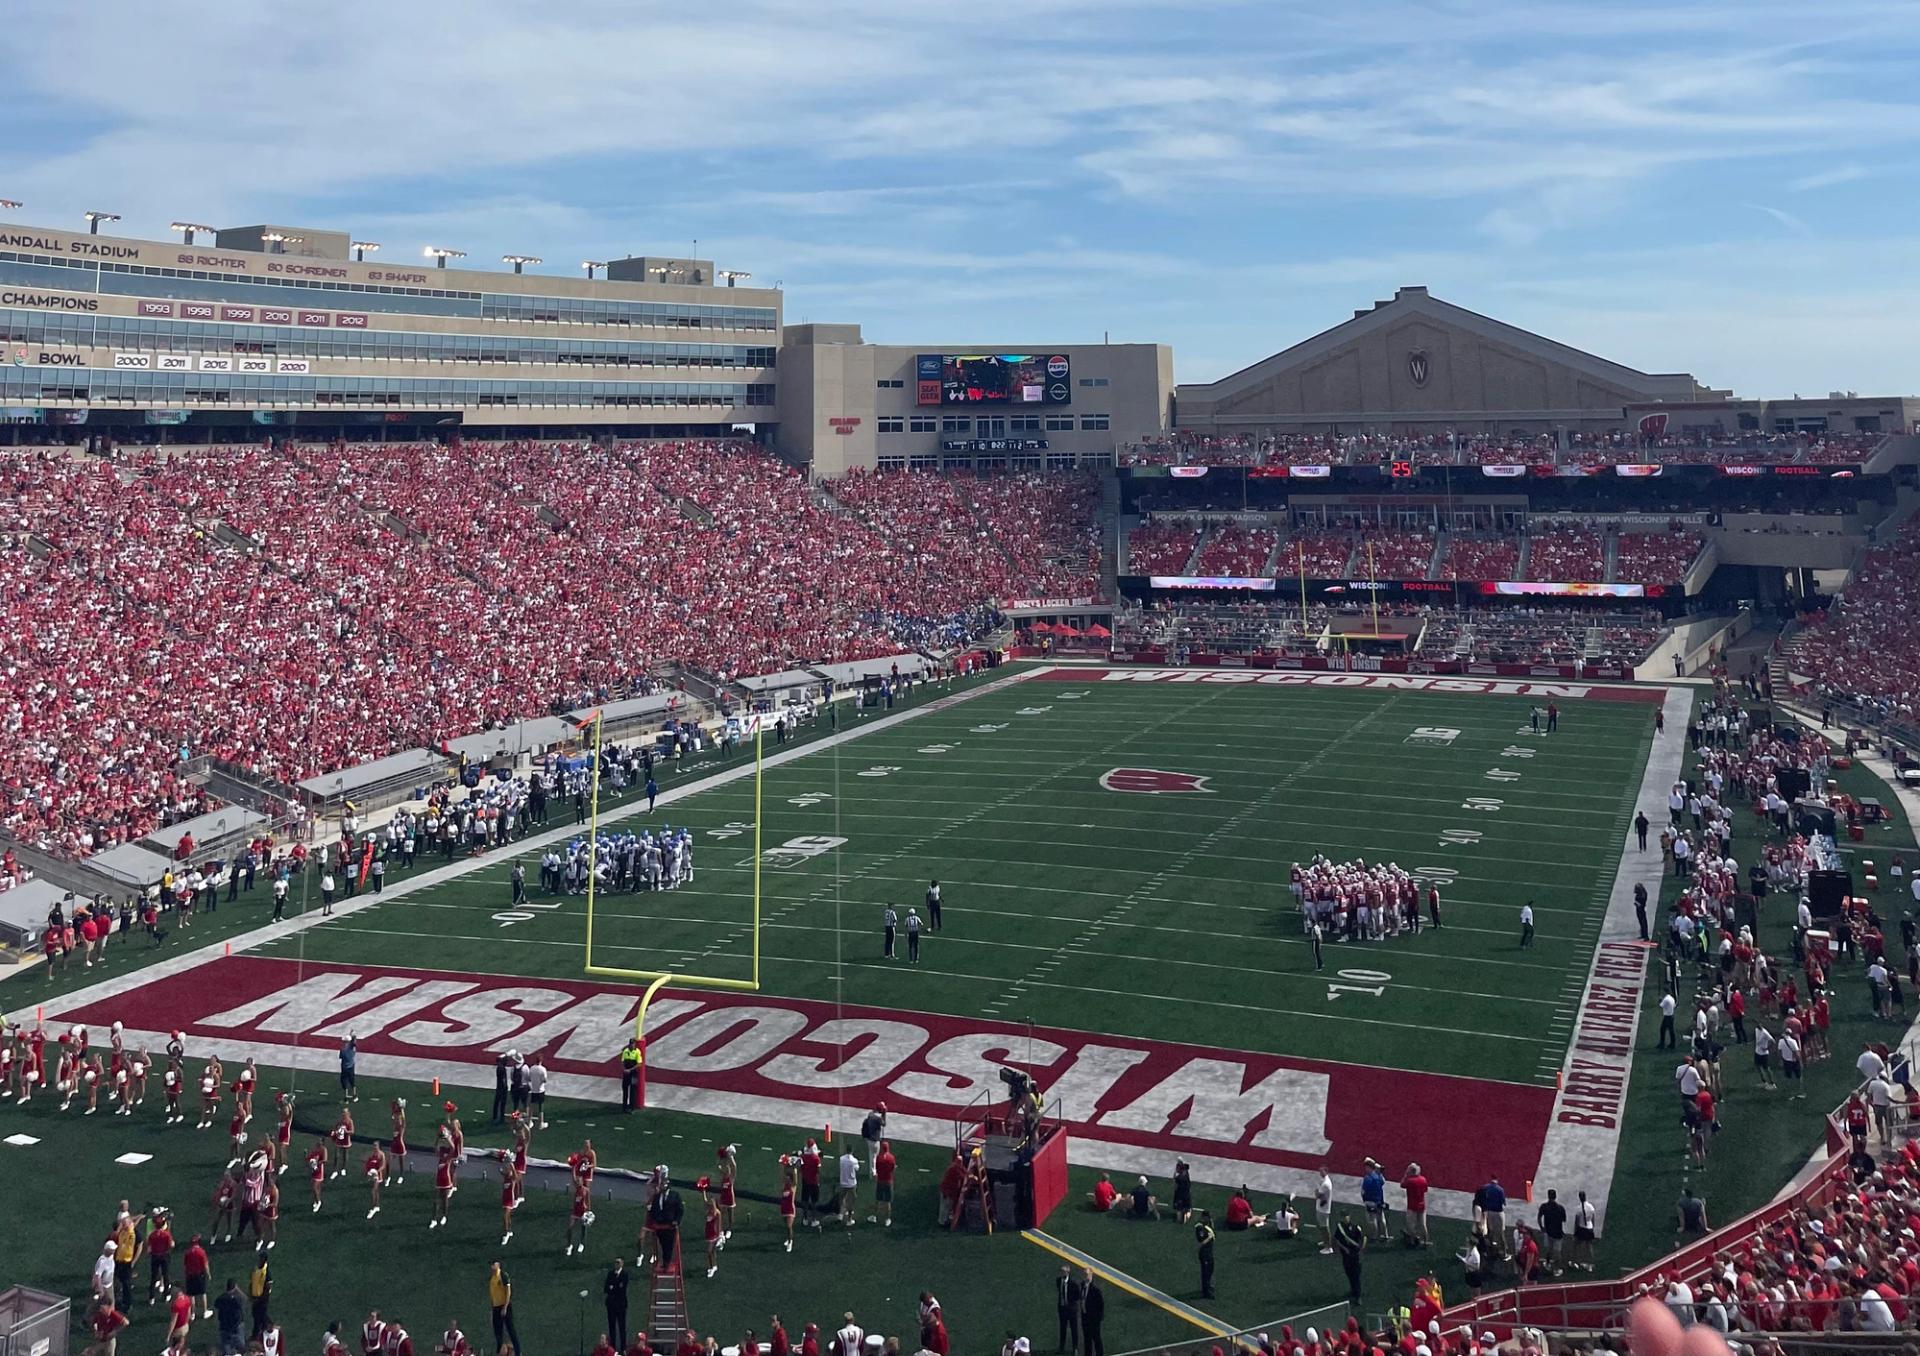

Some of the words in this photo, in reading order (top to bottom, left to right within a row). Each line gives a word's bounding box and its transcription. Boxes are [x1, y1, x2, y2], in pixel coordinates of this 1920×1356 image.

[71, 242, 139, 259] STADIUM
[197, 255, 246, 269] RICHTER
[286, 264, 347, 278] SCHREINER
[386, 273, 427, 283] SHAFER
[2, 292, 98, 311] CHAMPIONS
[145, 303, 170, 314] 1993
[187, 306, 212, 316] 1998
[227, 309, 251, 319] 1999
[265, 312, 289, 321] 2010
[305, 314, 325, 323] 2011
[342, 316, 364, 325] 2012
[39, 352, 86, 366] BOWL
[116, 356, 148, 366] 2000
[164, 358, 185, 368] 2011
[204, 360, 228, 369] 2012
[243, 361, 266, 370] 2013
[280, 363, 306, 372] 2020
[1392, 462, 1411, 477] 25
[1402, 583, 1451, 591] FOOTBALL
[1326, 656, 1381, 670] WISONSIN
[1100, 670, 1592, 698] WISCONSIN
[1594, 943, 1646, 981] FIELD
[1328, 969, 1392, 997] 10
[1575, 983, 1639, 1057] ALVAREZ
[194, 972, 1333, 1156] WISCONSIN
[1557, 1059, 1626, 1129] BARRY
